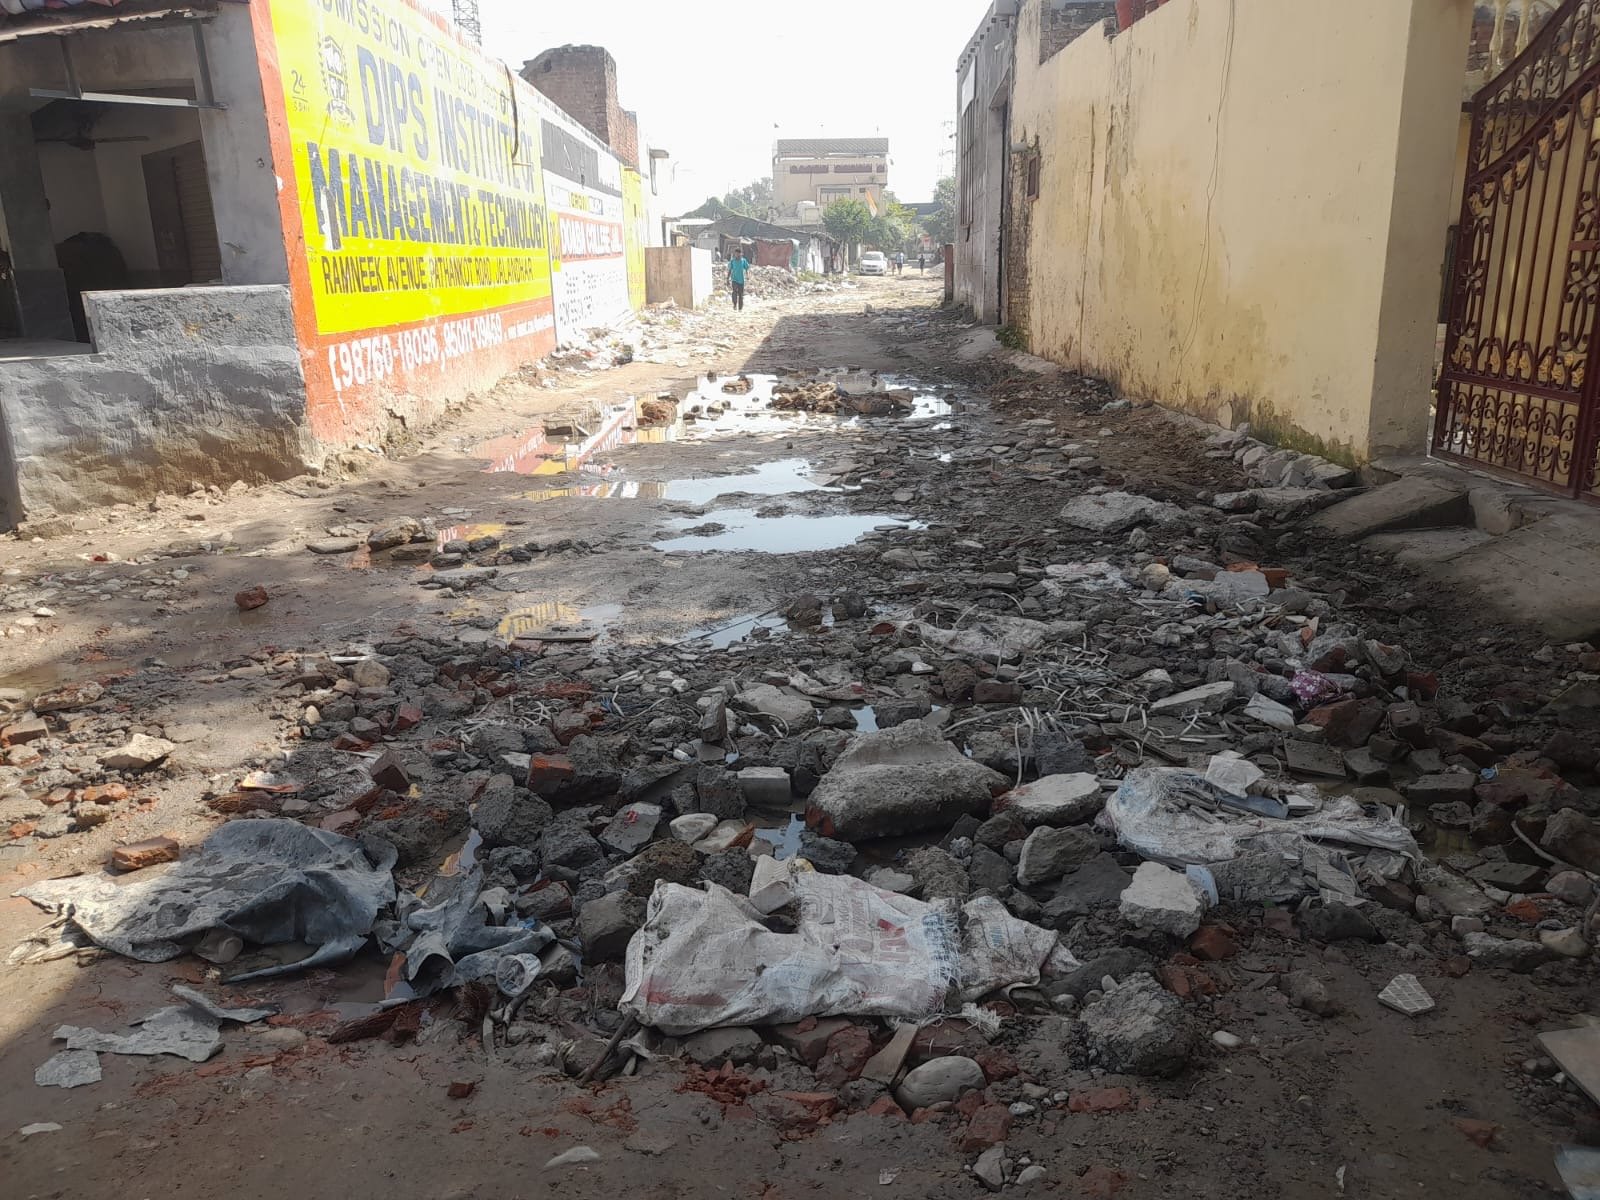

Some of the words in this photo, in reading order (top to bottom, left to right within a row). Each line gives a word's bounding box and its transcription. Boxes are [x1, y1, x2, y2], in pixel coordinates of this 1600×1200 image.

[357, 45, 429, 161] DIPS
[307, 142, 472, 249] MANAGEMENT
[478, 189, 546, 249] TECHNOLOGY
[321, 256, 384, 295] RAMNEEK
[386, 257, 429, 290] AVENUE
[429, 256, 474, 288] PATHANKOT
